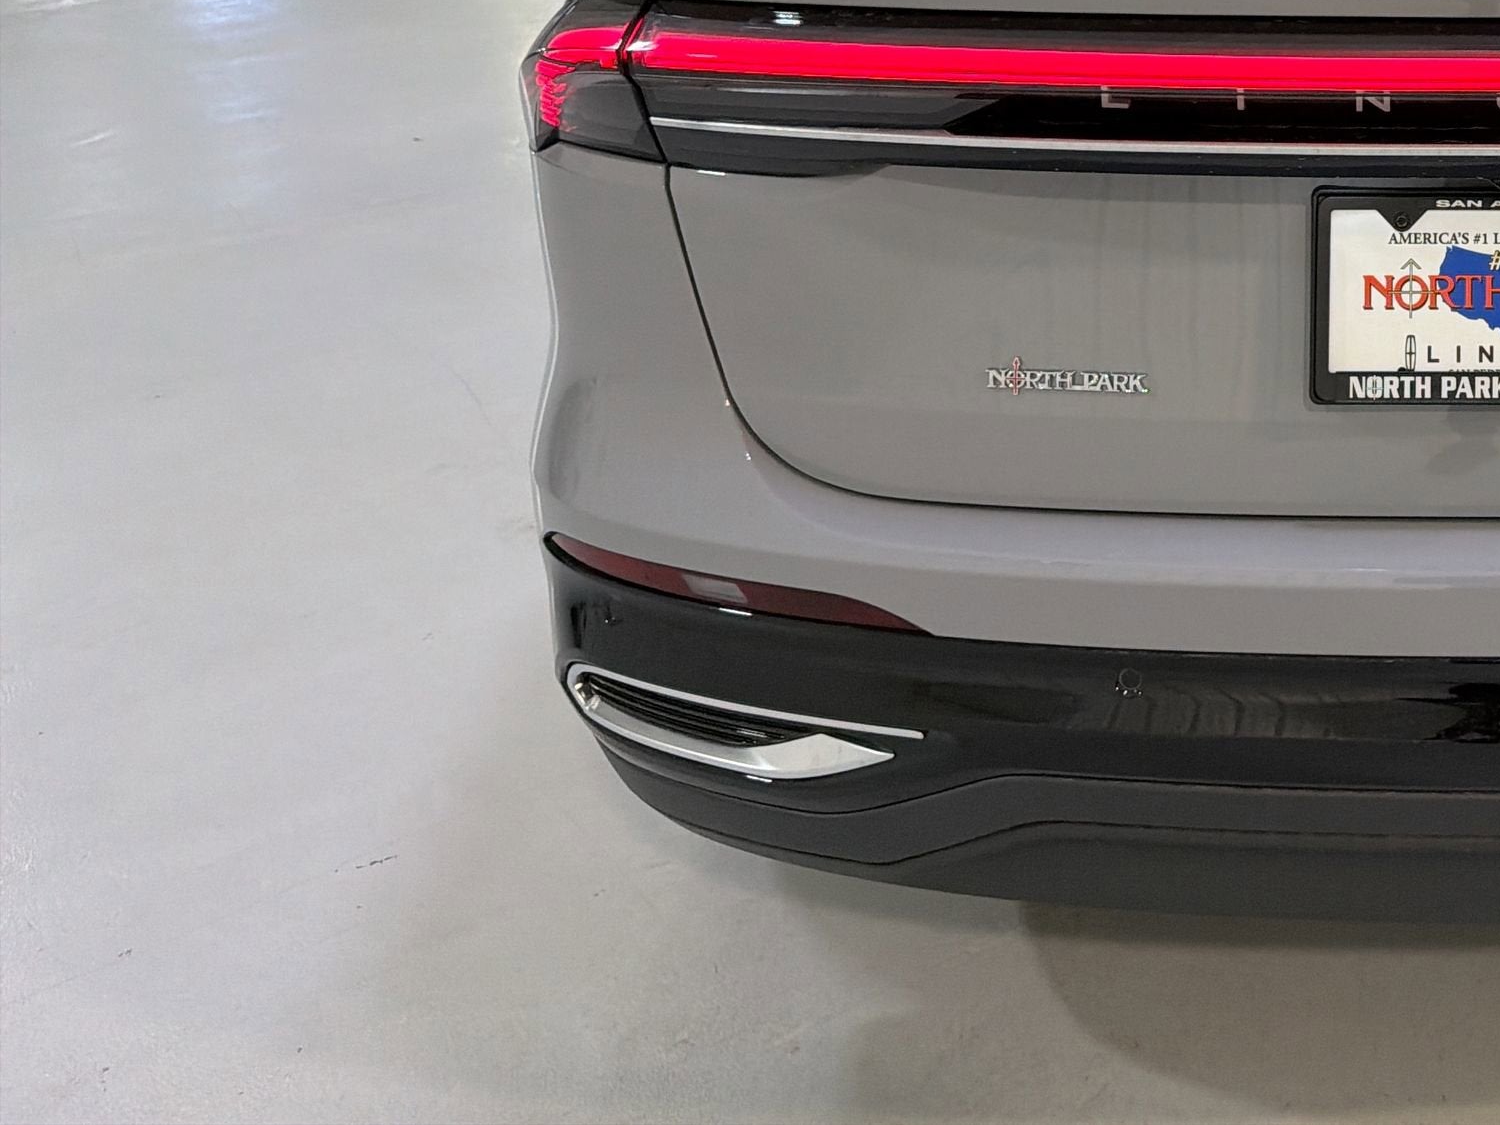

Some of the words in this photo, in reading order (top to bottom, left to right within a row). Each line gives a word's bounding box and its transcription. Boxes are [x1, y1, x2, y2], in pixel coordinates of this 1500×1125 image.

[1435, 199, 1482, 208] SAN
[1388, 232, 1469, 245] AMERICA'S
[1473, 232, 1488, 245] #1
[985, 369, 1075, 390] NORTH
[1081, 372, 1148, 393] PARK
[1349, 375, 1431, 399] NORTH
